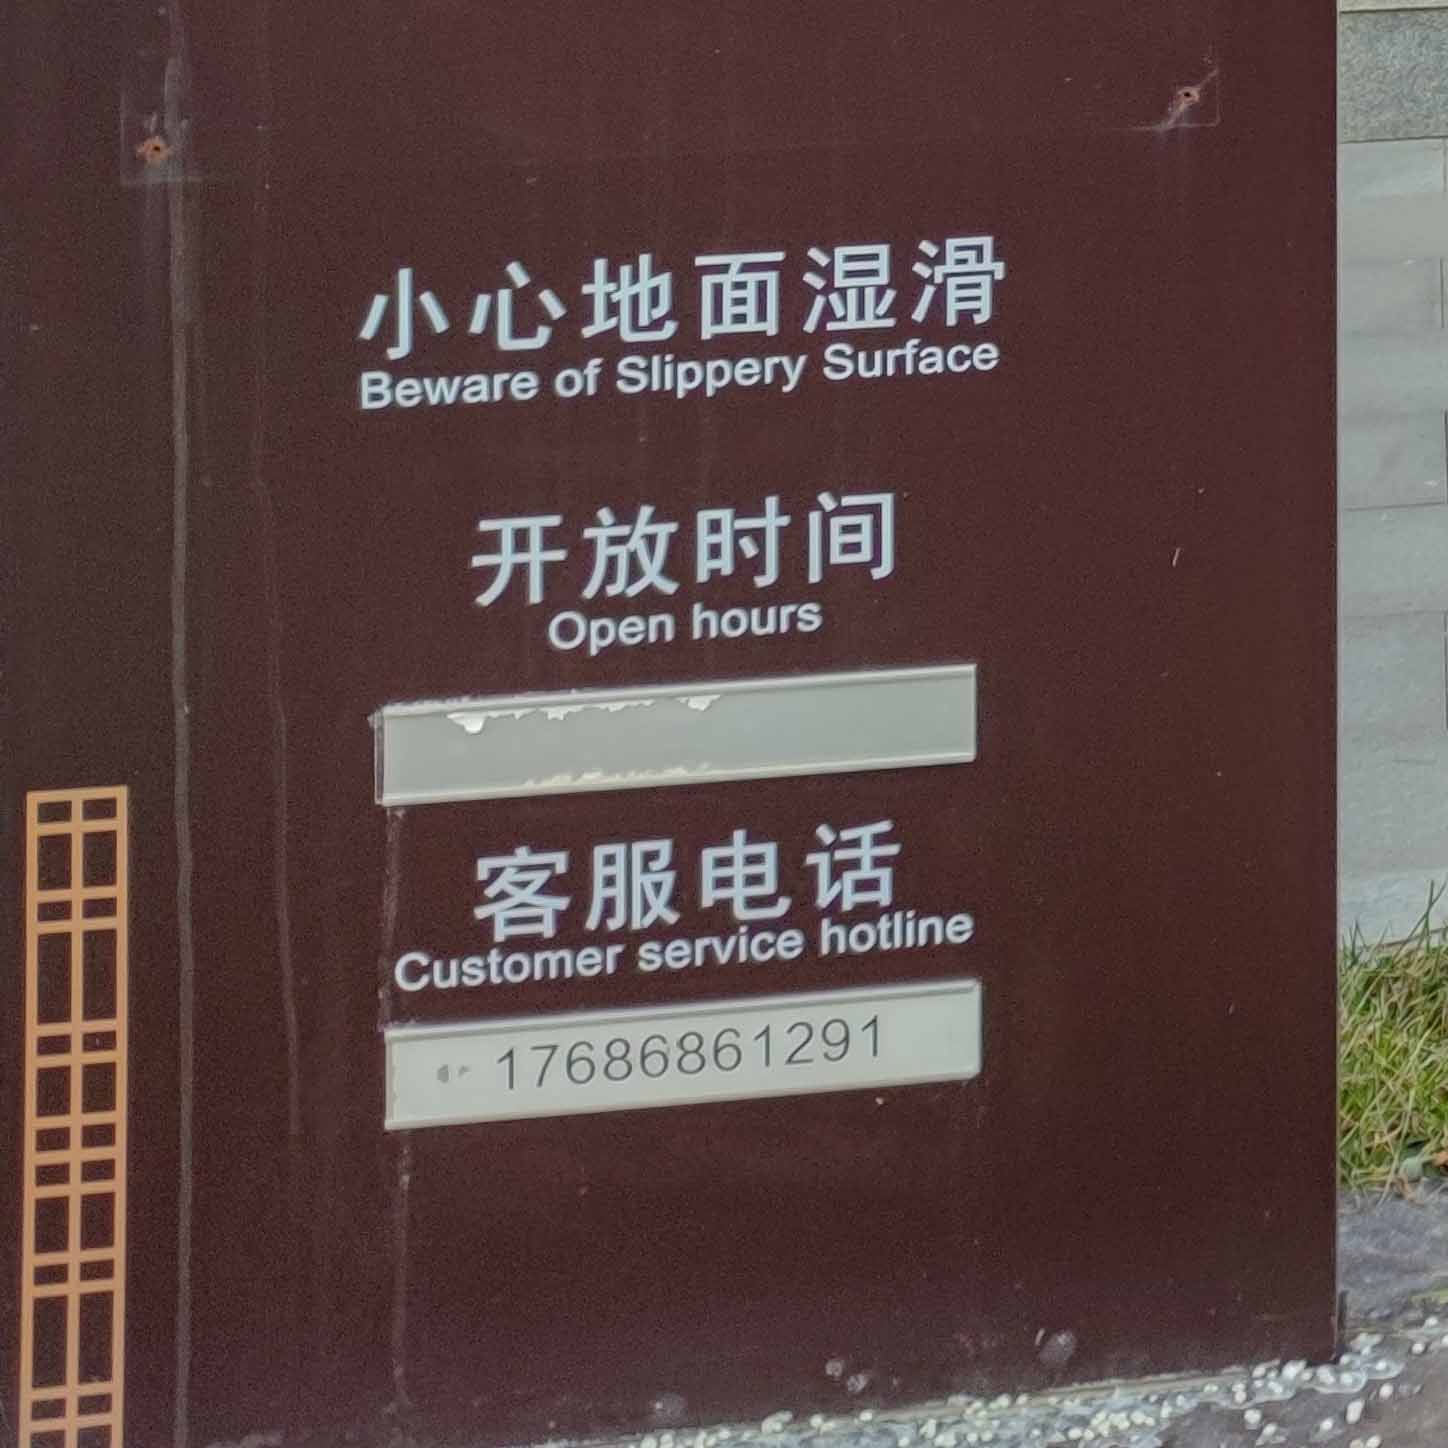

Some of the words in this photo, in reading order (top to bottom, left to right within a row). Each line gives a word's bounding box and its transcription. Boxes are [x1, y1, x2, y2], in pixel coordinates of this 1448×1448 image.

[359, 235, 1006, 359] 小心地面湿滑
[360, 368, 539, 411] Beware
[554, 357, 604, 399] of
[616, 353, 807, 400] Slippery
[823, 338, 1000, 382] Surface
[471, 492, 896, 608] 开放时间
[547, 610, 675, 656] Open
[692, 602, 823, 640] hours
[473, 820, 901, 953] 客服电话
[394, 944, 625, 993] Customer
[638, 925, 804, 973] service
[820, 911, 974, 957] hotline
[496, 1015, 882, 1091] 17686861291
